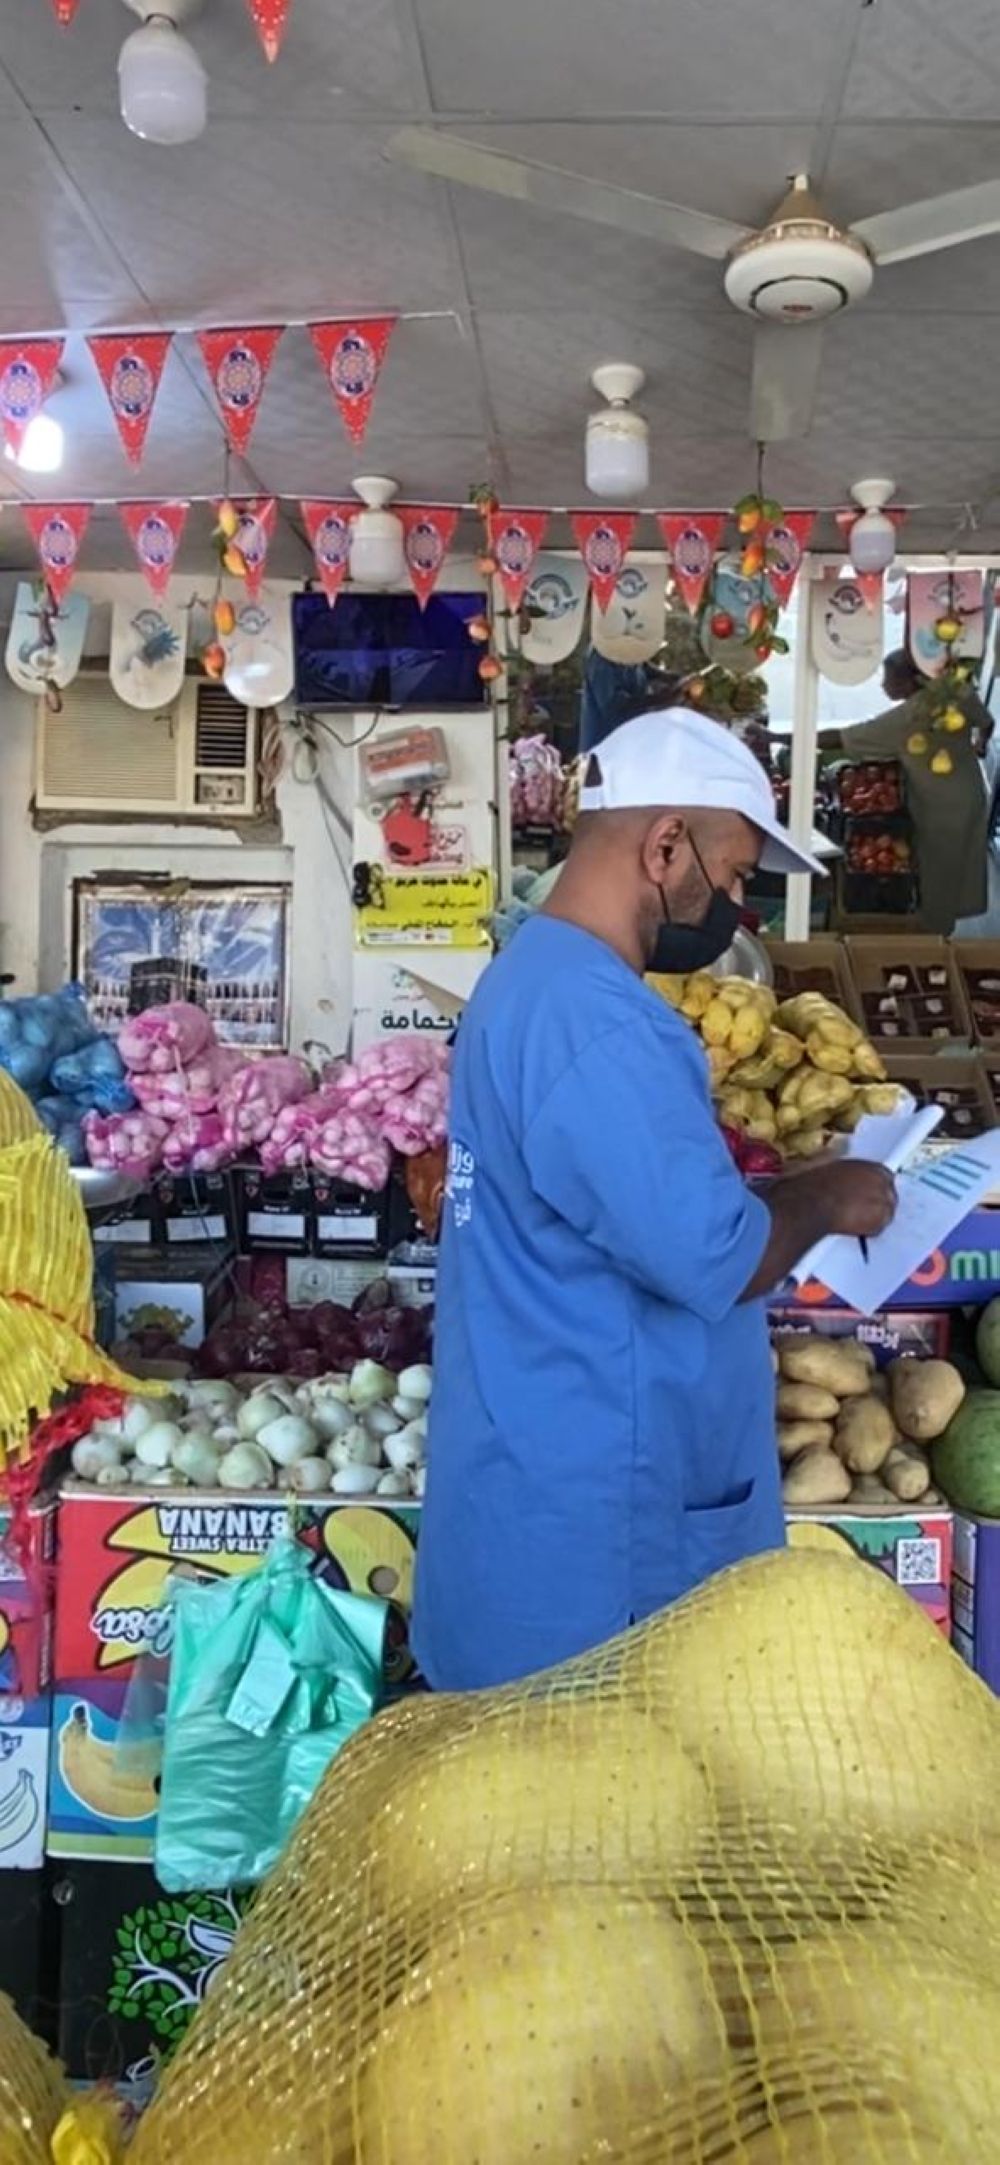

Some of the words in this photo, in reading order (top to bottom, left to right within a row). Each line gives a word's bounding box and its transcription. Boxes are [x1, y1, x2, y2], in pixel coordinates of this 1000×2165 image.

[159, 1507, 289, 1537] BANANA
[172, 1537, 220, 1551] SWEET
[225, 1538, 274, 1554] XTRA
